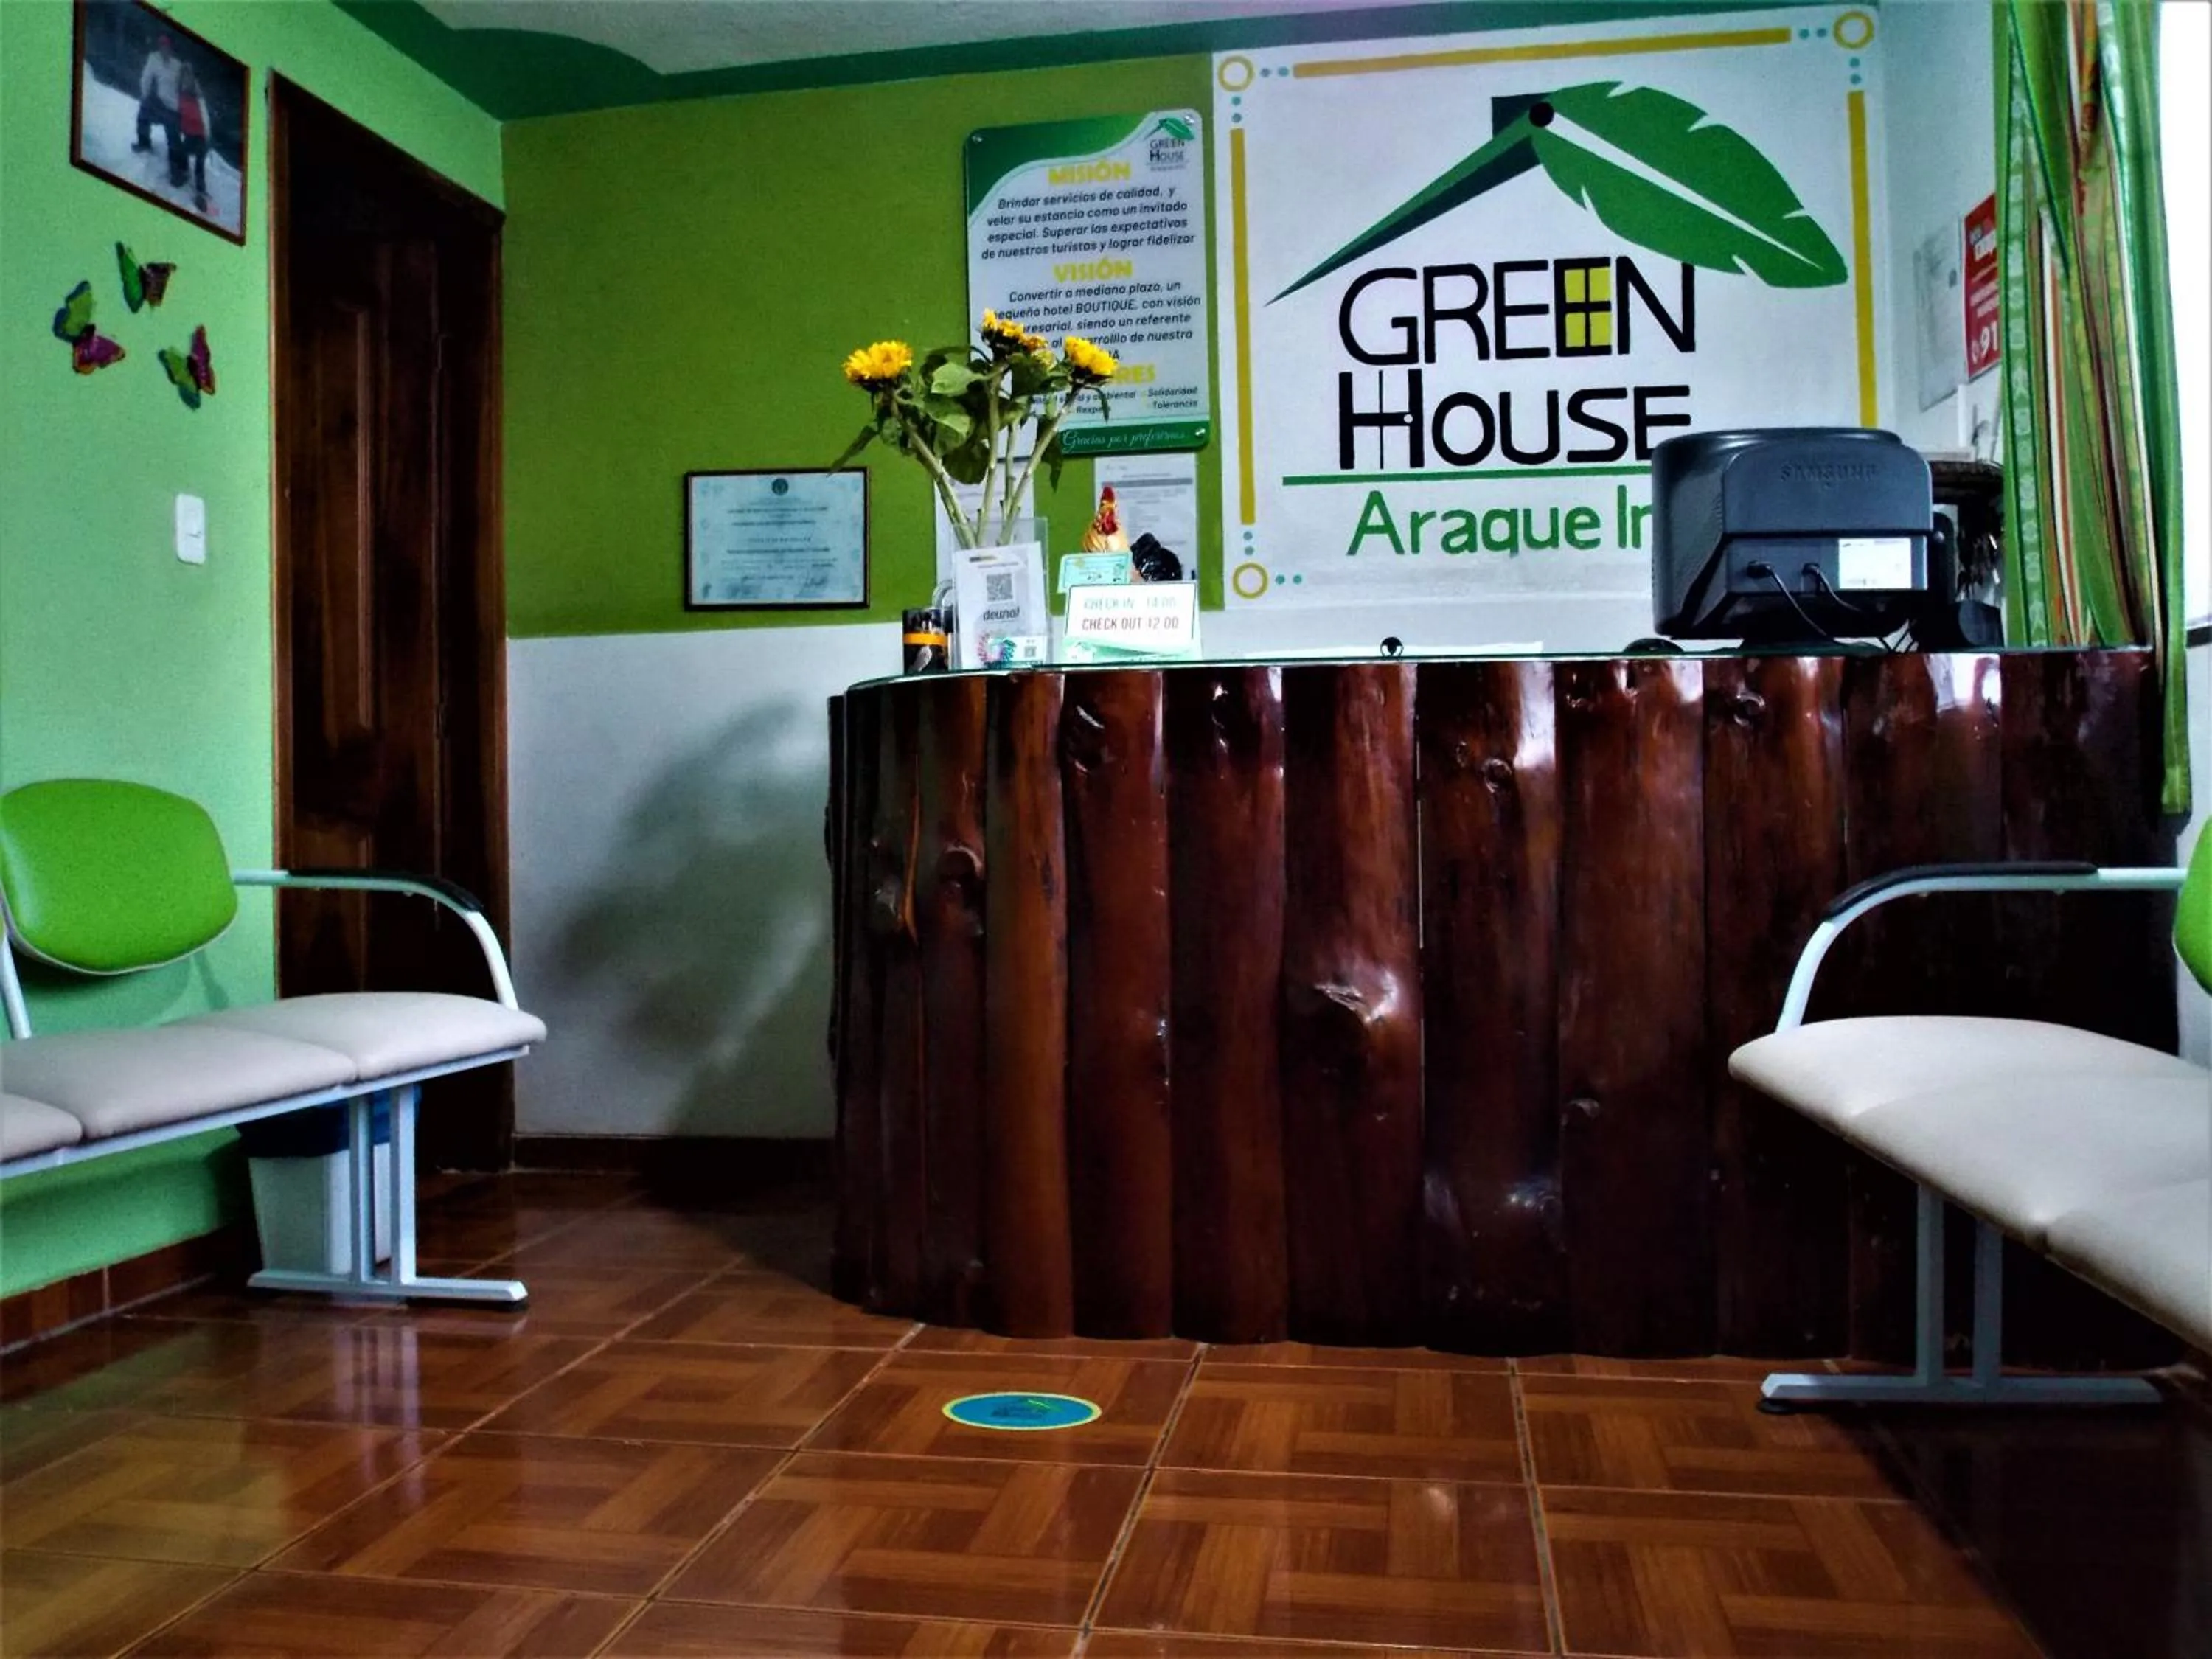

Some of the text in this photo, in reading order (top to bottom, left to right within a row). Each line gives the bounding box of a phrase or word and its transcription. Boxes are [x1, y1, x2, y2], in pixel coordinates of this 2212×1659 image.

[1048, 159, 1131, 185] MISIÓN
[998, 186, 1175, 209] Brindar servicios de calidad, y
[987, 201, 1188, 226] velar su estancia como un invitado
[1042, 226, 1088, 238] Superar
[1091, 223, 1107, 234] las
[1110, 218, 1188, 233] expectativas
[981, 234, 1195, 259] de nuestros turistas y lograr fidelizar
[1053, 257, 1133, 283] VISIÓN
[1009, 288, 1063, 302] Convertir
[1065, 290, 1073, 298] a
[1075, 284, 1126, 297] mediano
[1166, 282, 1181, 291] un
[1043, 303, 1073, 316] hotel
[1142, 299, 1163, 309] con
[1166, 295, 1201, 307] visión
[1339, 256, 1696, 366] GREEN
[1023, 313, 1192, 333] resarial, siendo un referente
[1051, 337, 1062, 348] al
[1130, 332, 1144, 342] de
[1146, 330, 1193, 341] nuestra
[1339, 369, 1691, 470] HOUSE
[1346, 490, 1601, 557] Araque
[1082, 617, 1118, 631] CHECK
[1121, 616, 1143, 630] OUT
